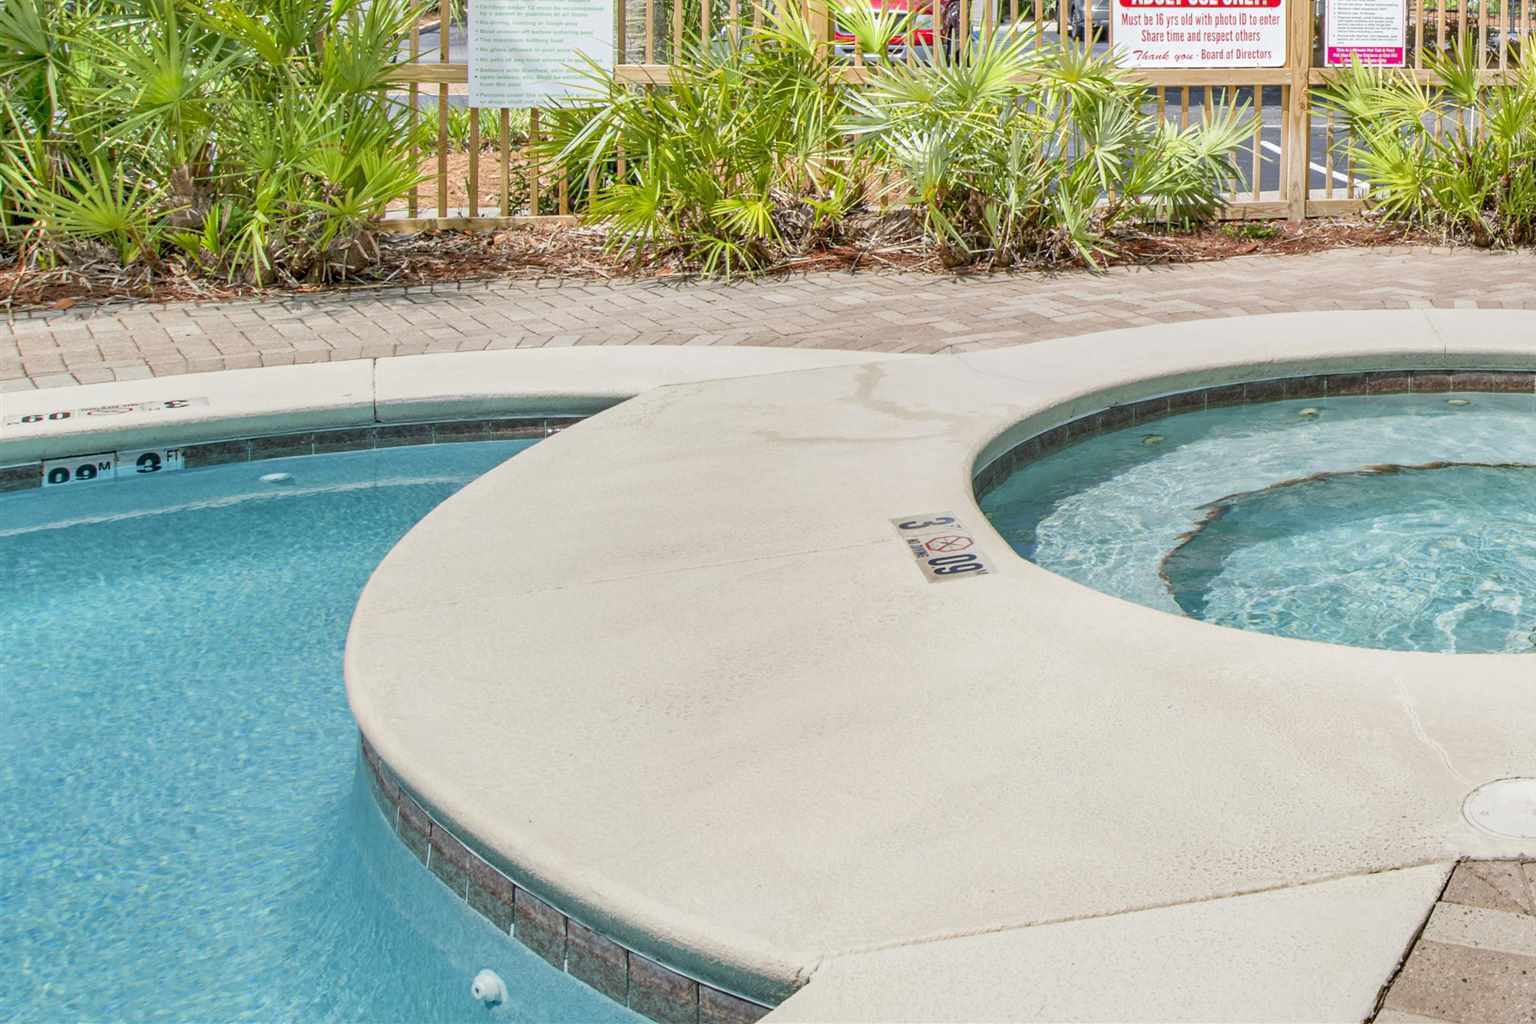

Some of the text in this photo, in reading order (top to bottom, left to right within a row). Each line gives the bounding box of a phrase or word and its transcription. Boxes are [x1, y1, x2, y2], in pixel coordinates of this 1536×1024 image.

[1121, 13, 1280, 28] Must be 16 yrs old with photo ID to enter
[1141, 30, 1261, 45] Share time and respect others
[1132, 50, 1170, 61] Thank
[1174, 52, 1193, 63] you
[1201, 48, 1224, 60] Board
[1226, 48, 1233, 60] of
[1236, 48, 1272, 60] Directors
